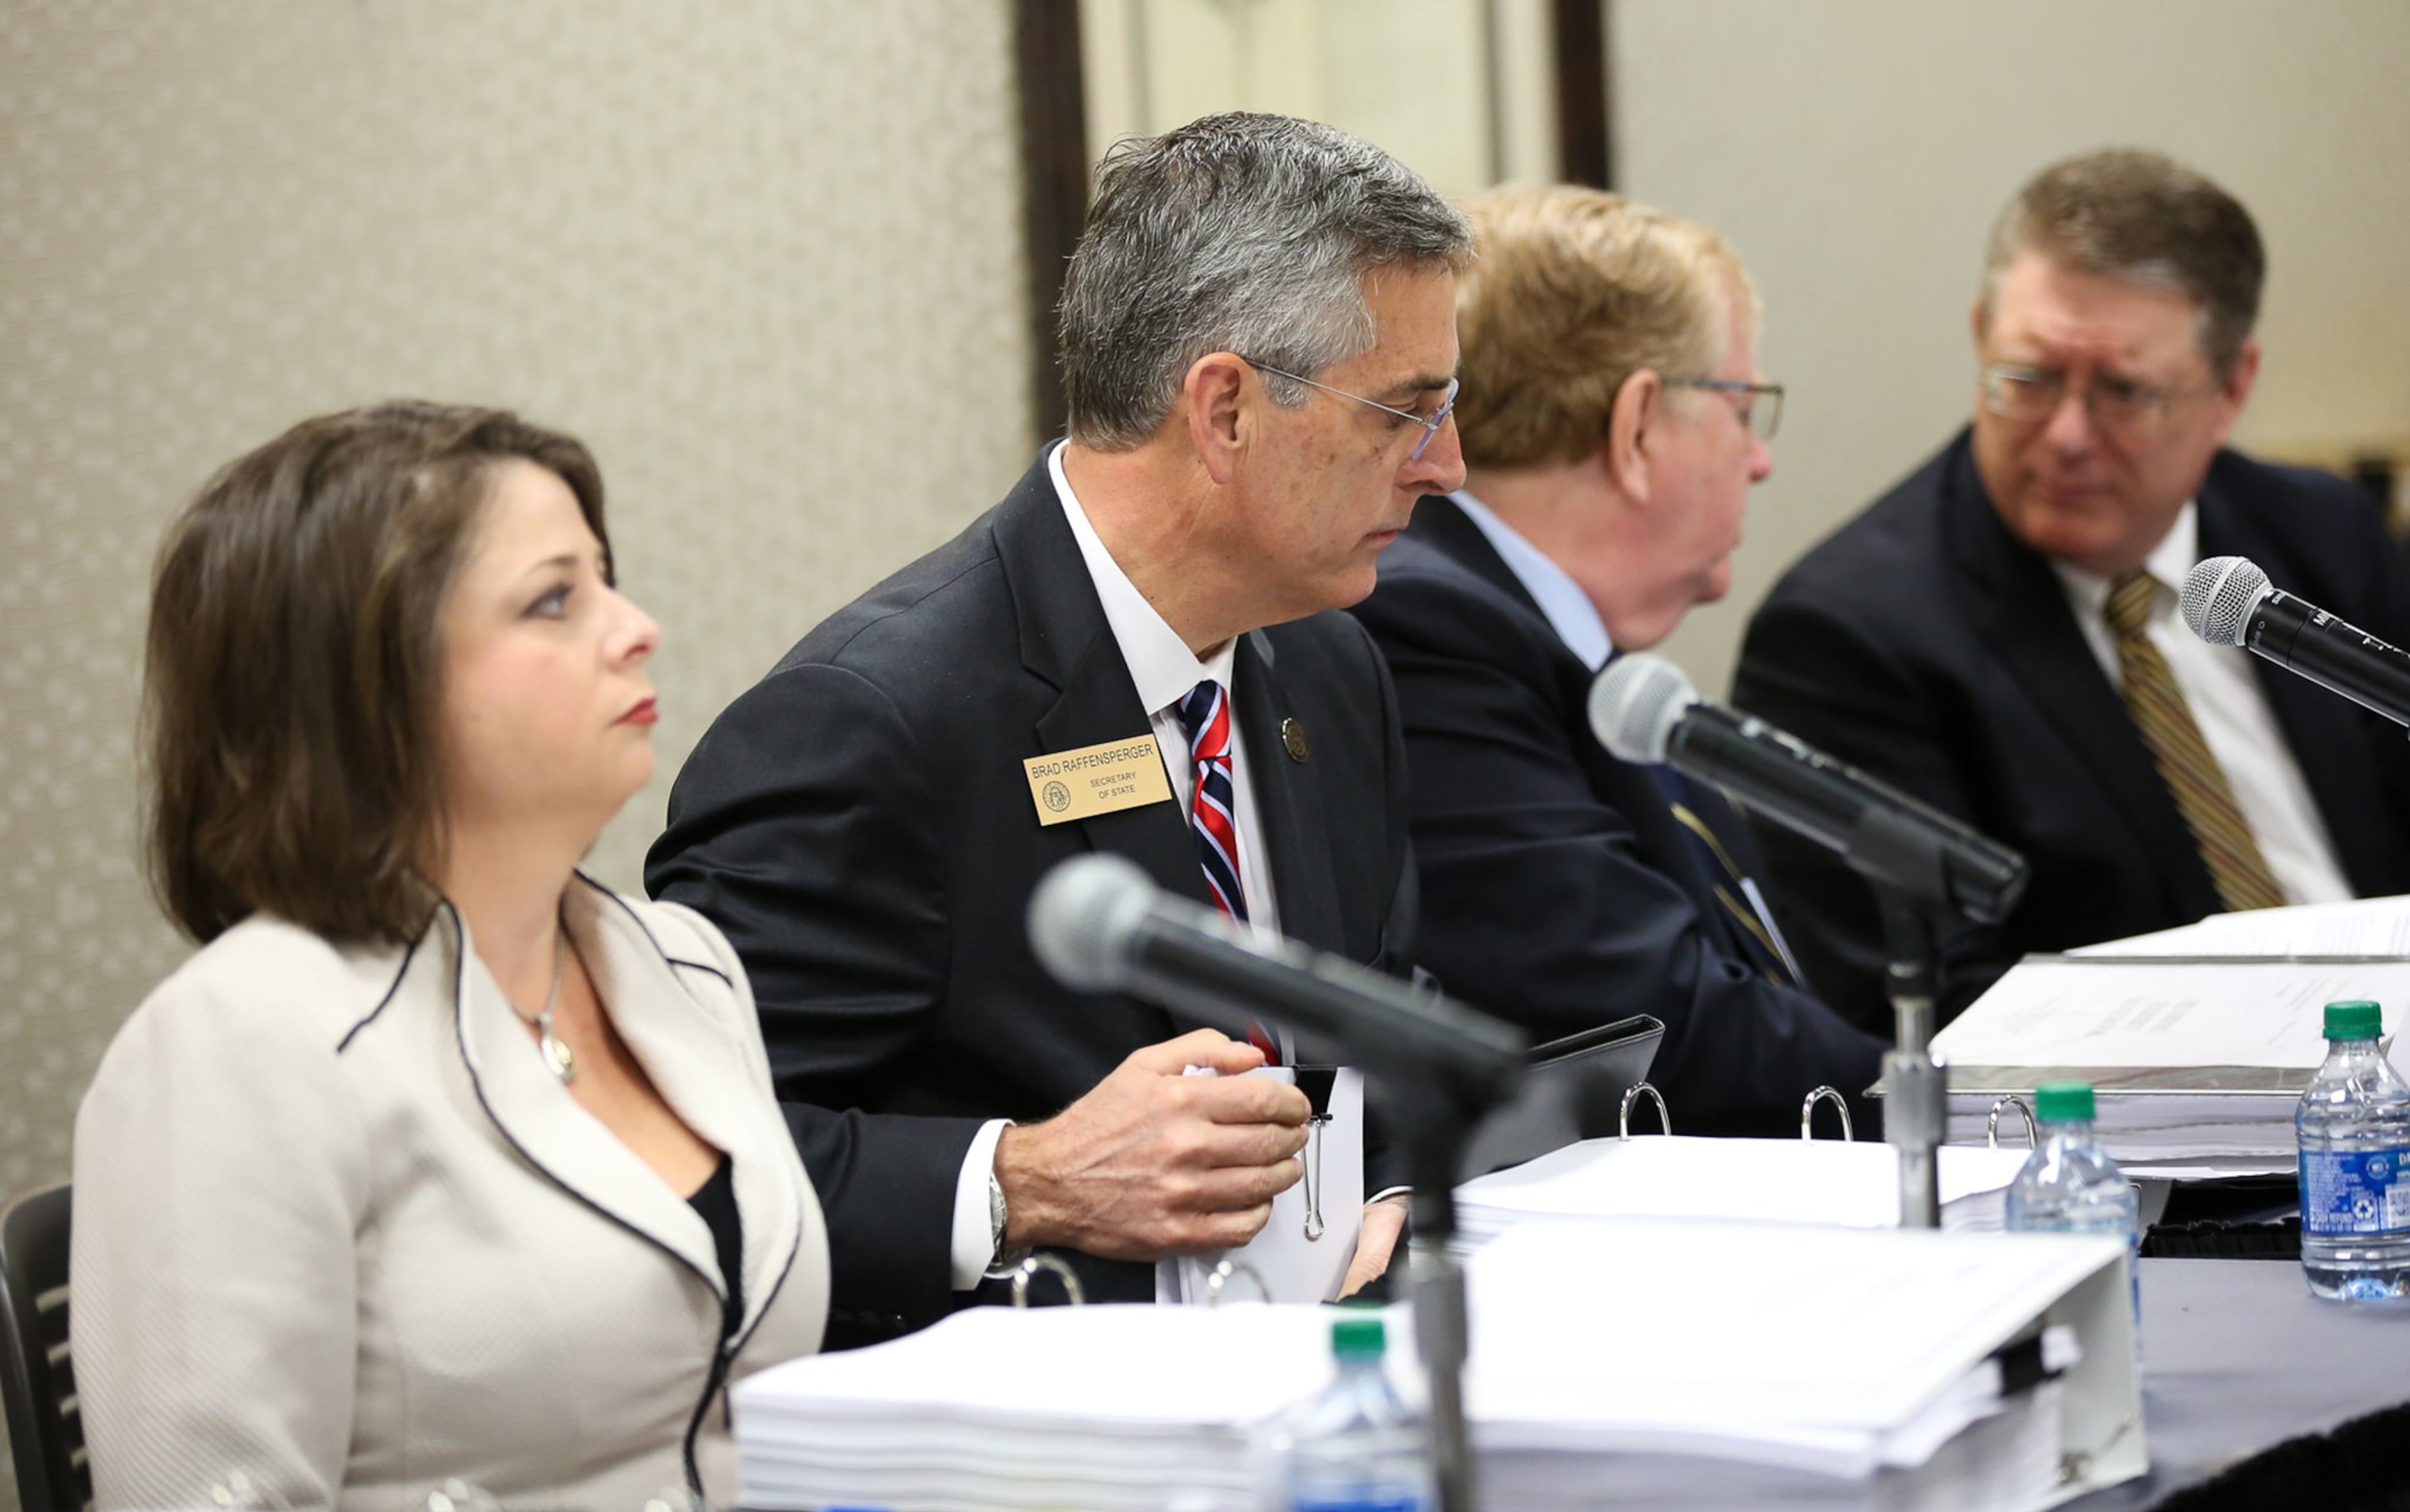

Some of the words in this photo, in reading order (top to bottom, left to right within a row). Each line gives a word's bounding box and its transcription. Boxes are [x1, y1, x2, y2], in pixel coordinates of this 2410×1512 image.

[1031, 762, 1061, 779] BRAD
[1063, 744, 1153, 773] RAFFENSPERGER
[1090, 771, 1137, 788] SECRETARY
[1099, 788, 1109, 799] OF
[1112, 785, 1136, 797] STATE
